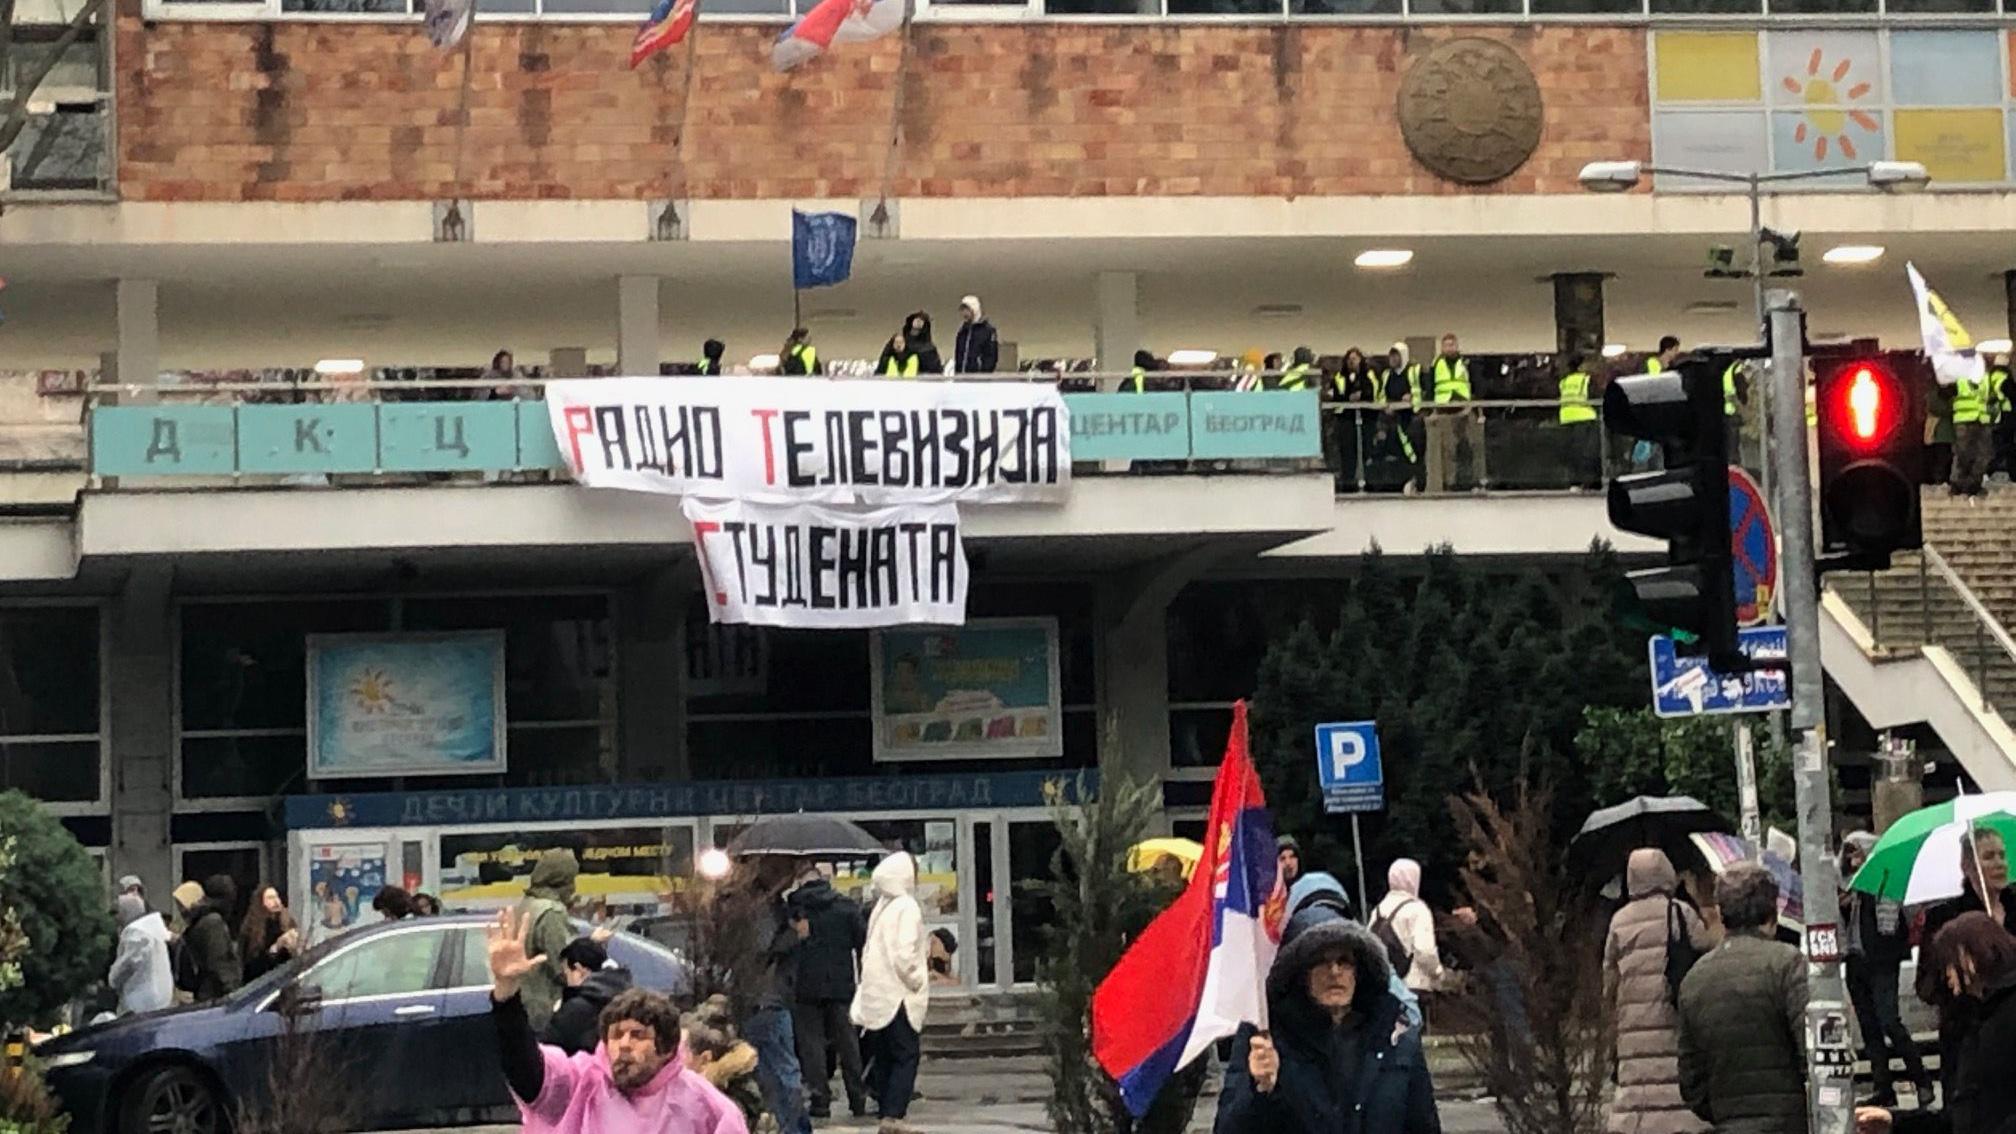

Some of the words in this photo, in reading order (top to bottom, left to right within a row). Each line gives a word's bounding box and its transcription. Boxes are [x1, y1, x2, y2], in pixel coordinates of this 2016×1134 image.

[145, 417, 181, 463] Д
[294, 417, 324, 453] К
[435, 415, 470, 459] Ц
[563, 405, 724, 481] РАДИО
[751, 405, 1057, 487] ТЕЛЕВИЗИЈА
[1070, 412, 1180, 442] ЦЕНТАР
[1205, 413, 1306, 435] БЕОГРАД
[1331, 731, 1366, 780] P
